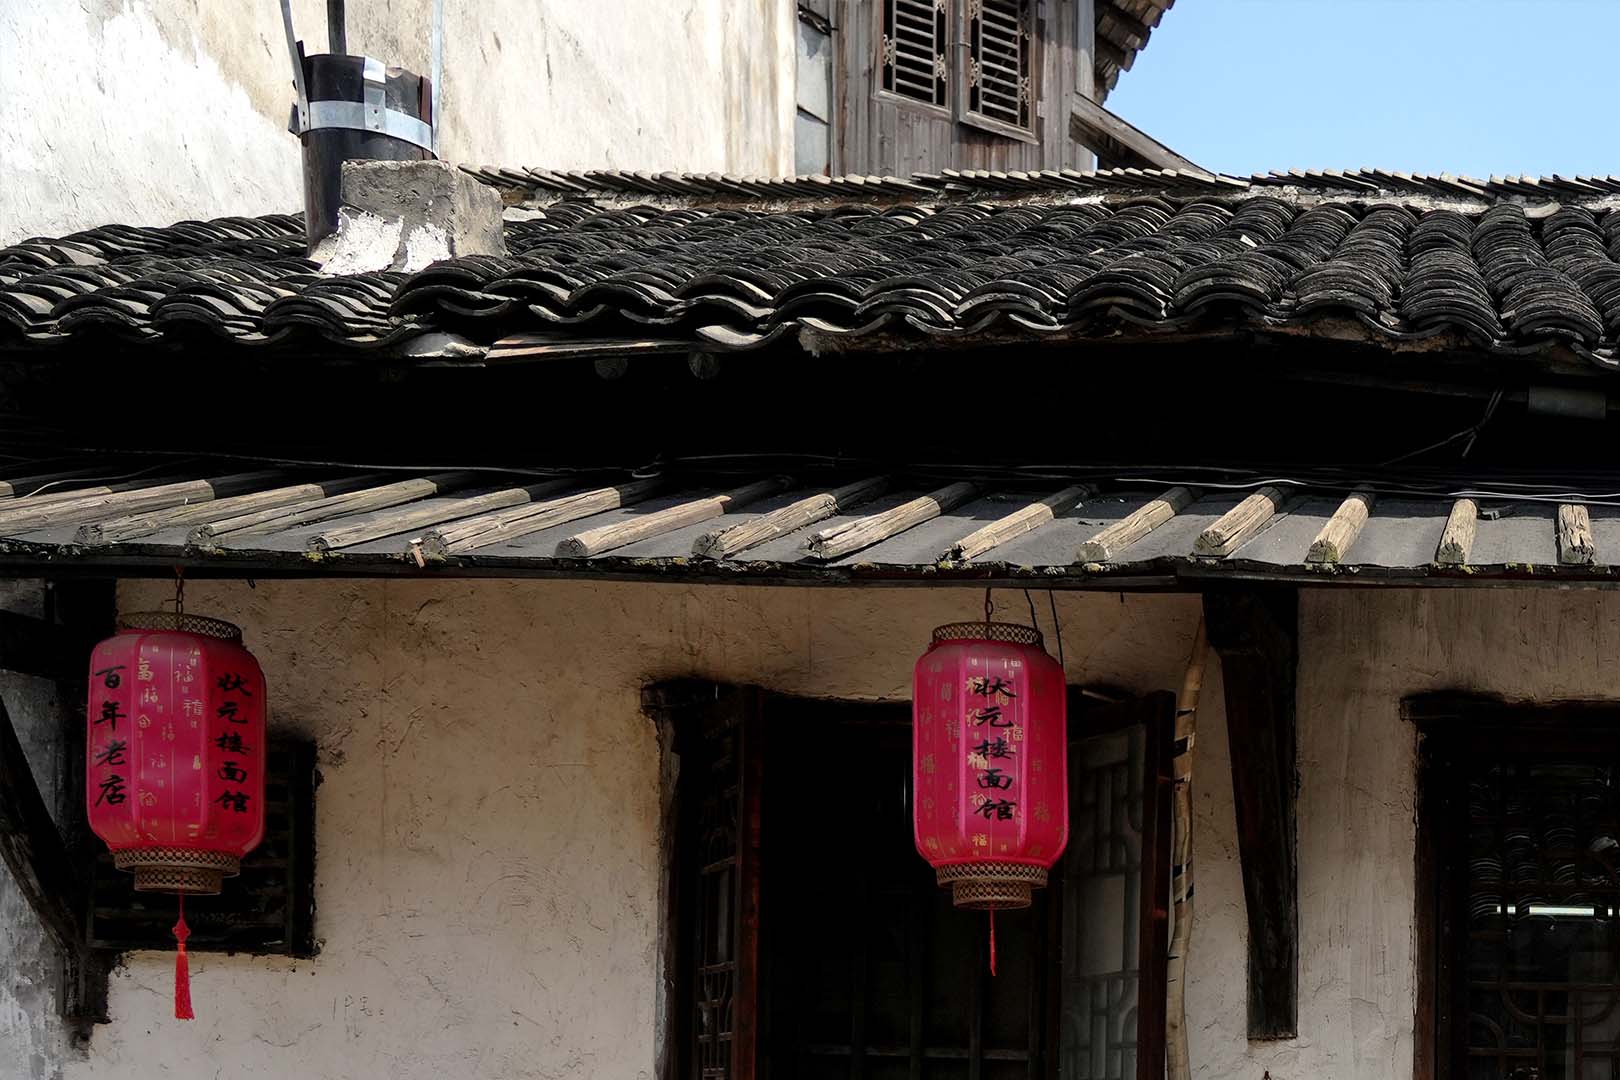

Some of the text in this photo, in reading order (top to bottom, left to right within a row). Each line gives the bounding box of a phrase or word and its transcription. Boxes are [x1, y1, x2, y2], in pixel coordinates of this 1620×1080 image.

[94, 665, 127, 808] 百年老店
[973, 676, 1017, 822] 状元楼面馆
